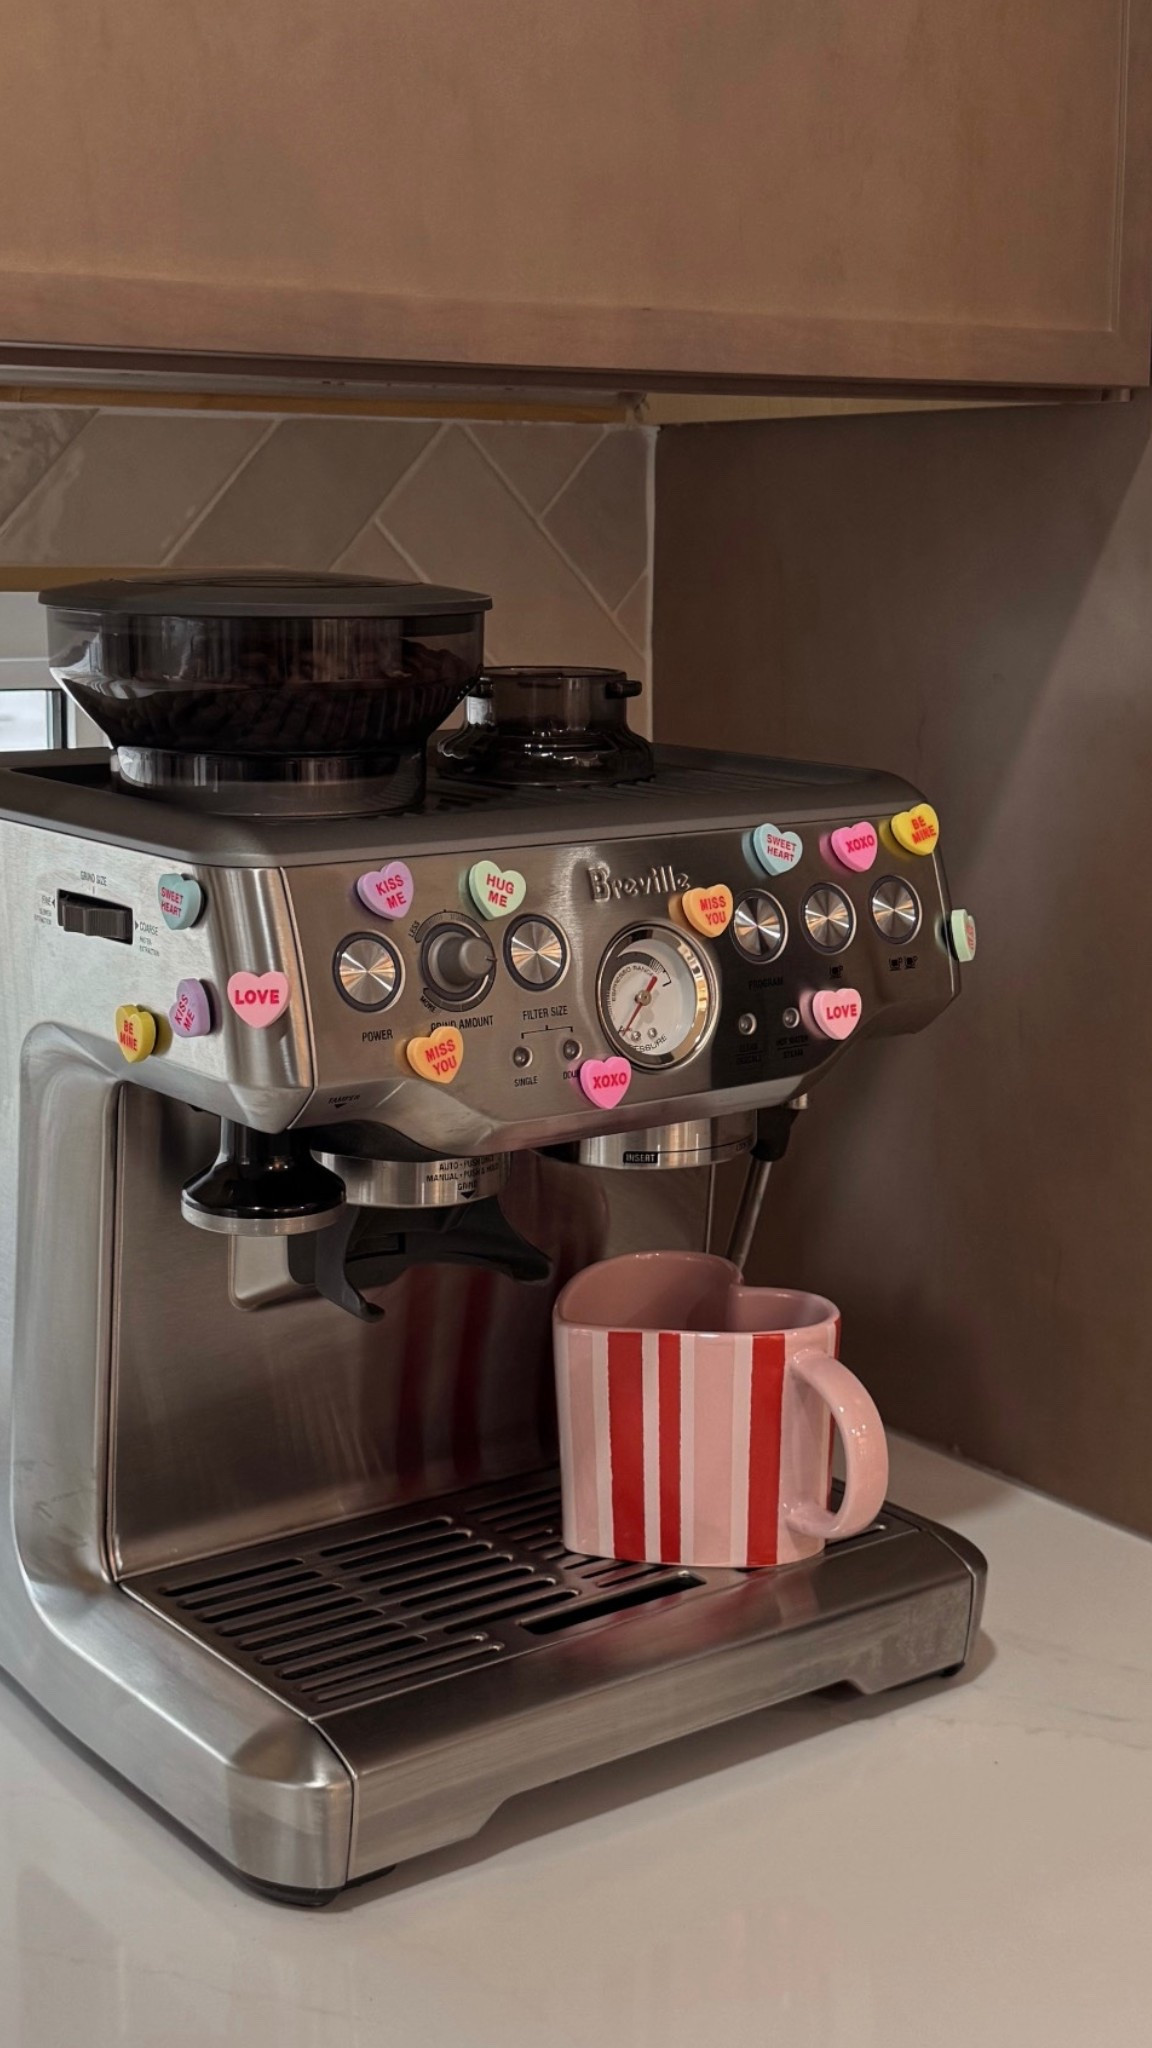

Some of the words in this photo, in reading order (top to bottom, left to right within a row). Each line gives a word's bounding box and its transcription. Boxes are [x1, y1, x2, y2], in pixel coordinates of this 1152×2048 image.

[912, 816, 927, 830] BE
[767, 833, 797, 853] SWEET
[911, 825, 937, 845] MINE
[845, 834, 875, 854] XOXO
[767, 846, 795, 863] HEART
[375, 873, 404, 896] KISS
[486, 872, 515, 894] HUG
[589, 864, 691, 903] Breville
[160, 886, 184, 905] SWEET
[387, 895, 407, 911] ME
[488, 890, 508, 908] ME
[699, 895, 727, 912] MISS
[160, 900, 182, 917] HEART
[705, 911, 727, 926] YOU
[139, 921, 159, 936] COARSE
[408, 920, 421, 938] LESS
[234, 989, 280, 1005] LOVE
[174, 994, 189, 1025] KISS
[522, 1007, 549, 1021] FILTER
[550, 1005, 568, 1017] SIZE
[826, 1003, 857, 1020] LOVE
[123, 1019, 134, 1035] BE
[183, 1009, 196, 1031] ME
[458, 1015, 494, 1030] AMOUNT
[119, 1031, 138, 1051] MINE
[361, 1028, 394, 1042] POWER
[425, 1039, 456, 1063] MISS
[433, 1055, 457, 1076] YOU
[514, 1076, 538, 1087] SINGLE
[593, 1073, 628, 1090] XOXO
[439, 1161, 459, 1171] AUTO
[625, 1153, 656, 1163] INSERT
[426, 1172, 459, 1182] MANUAL
[457, 1179, 478, 1191] GRIND
